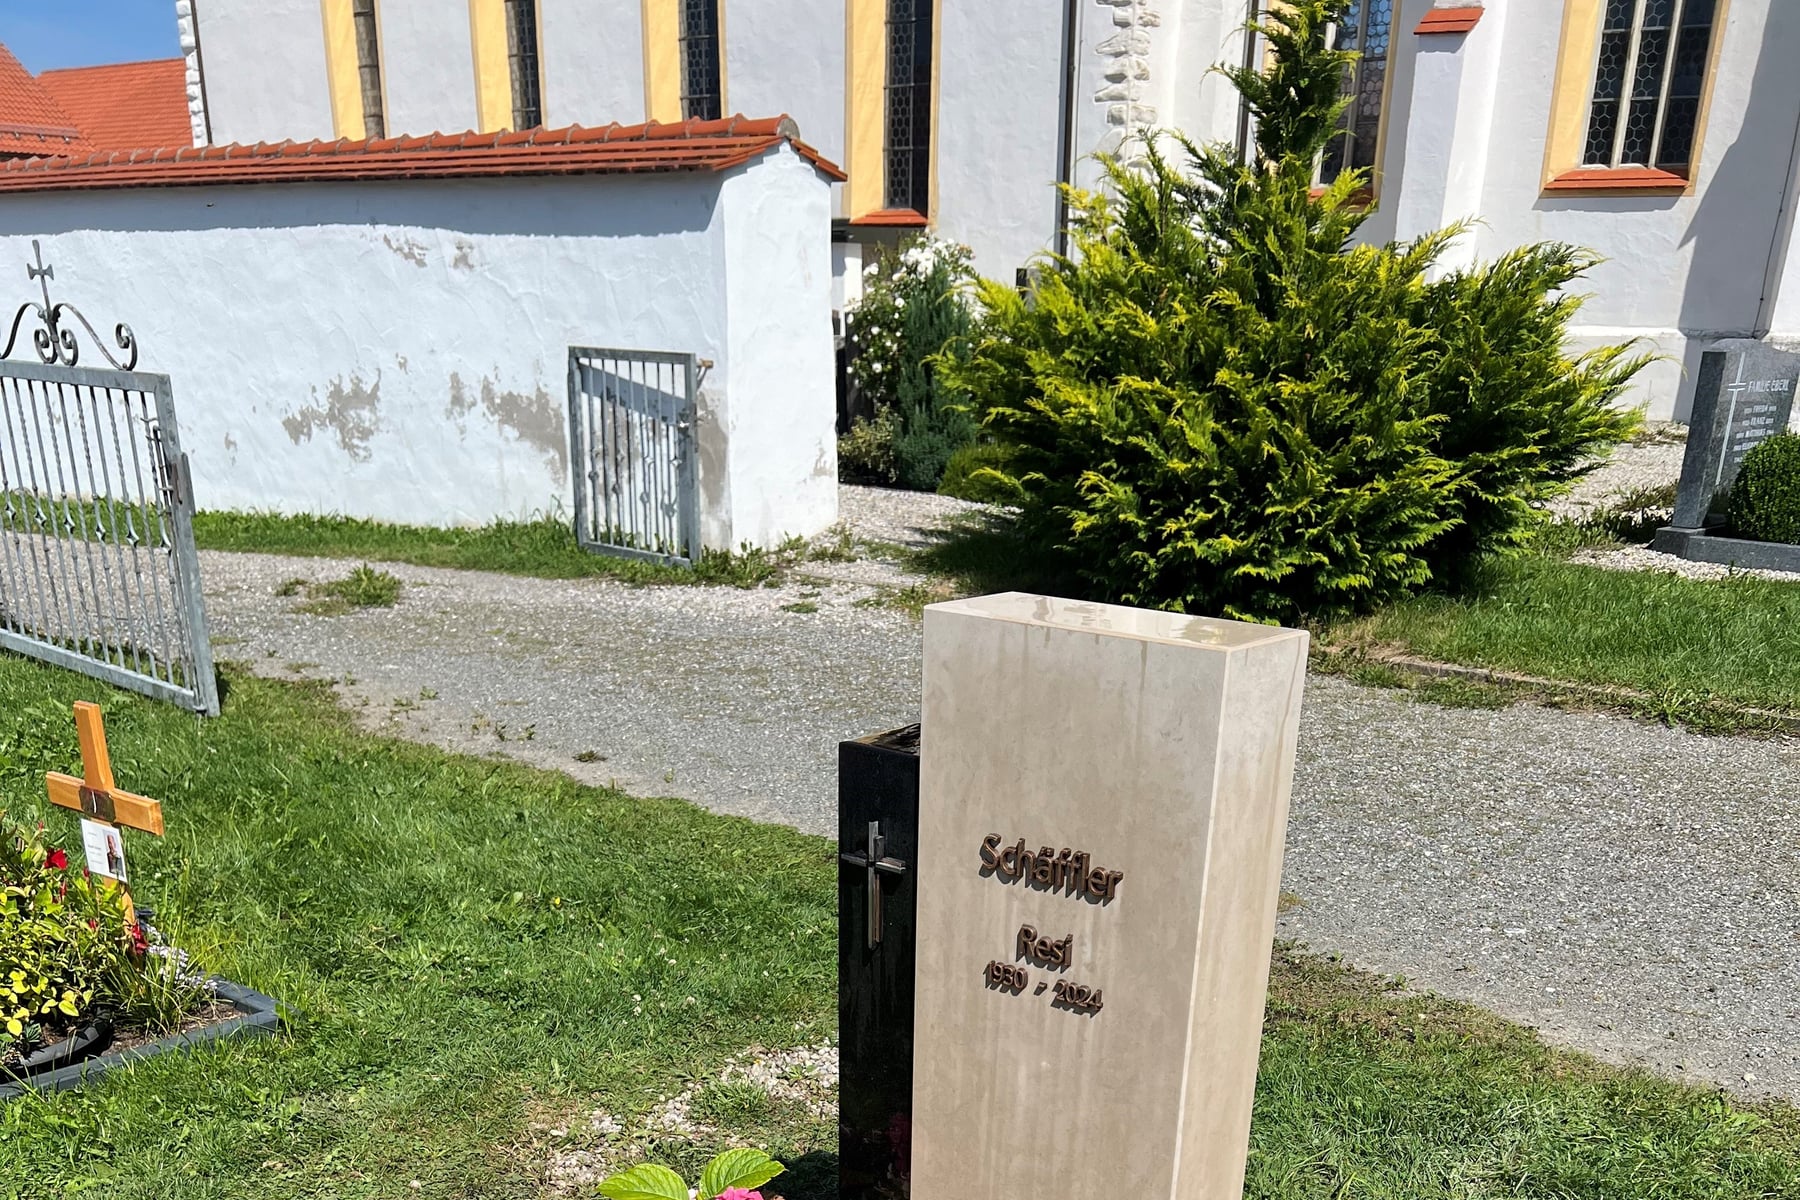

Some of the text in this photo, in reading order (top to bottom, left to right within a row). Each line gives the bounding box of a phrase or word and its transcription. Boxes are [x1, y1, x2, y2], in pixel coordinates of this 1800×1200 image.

[979, 833, 1123, 901] Schäffler
[1017, 923, 1073, 968] Resi
[984, 960, 1028, 991] 1930
[1053, 979, 1103, 1012] 2024
